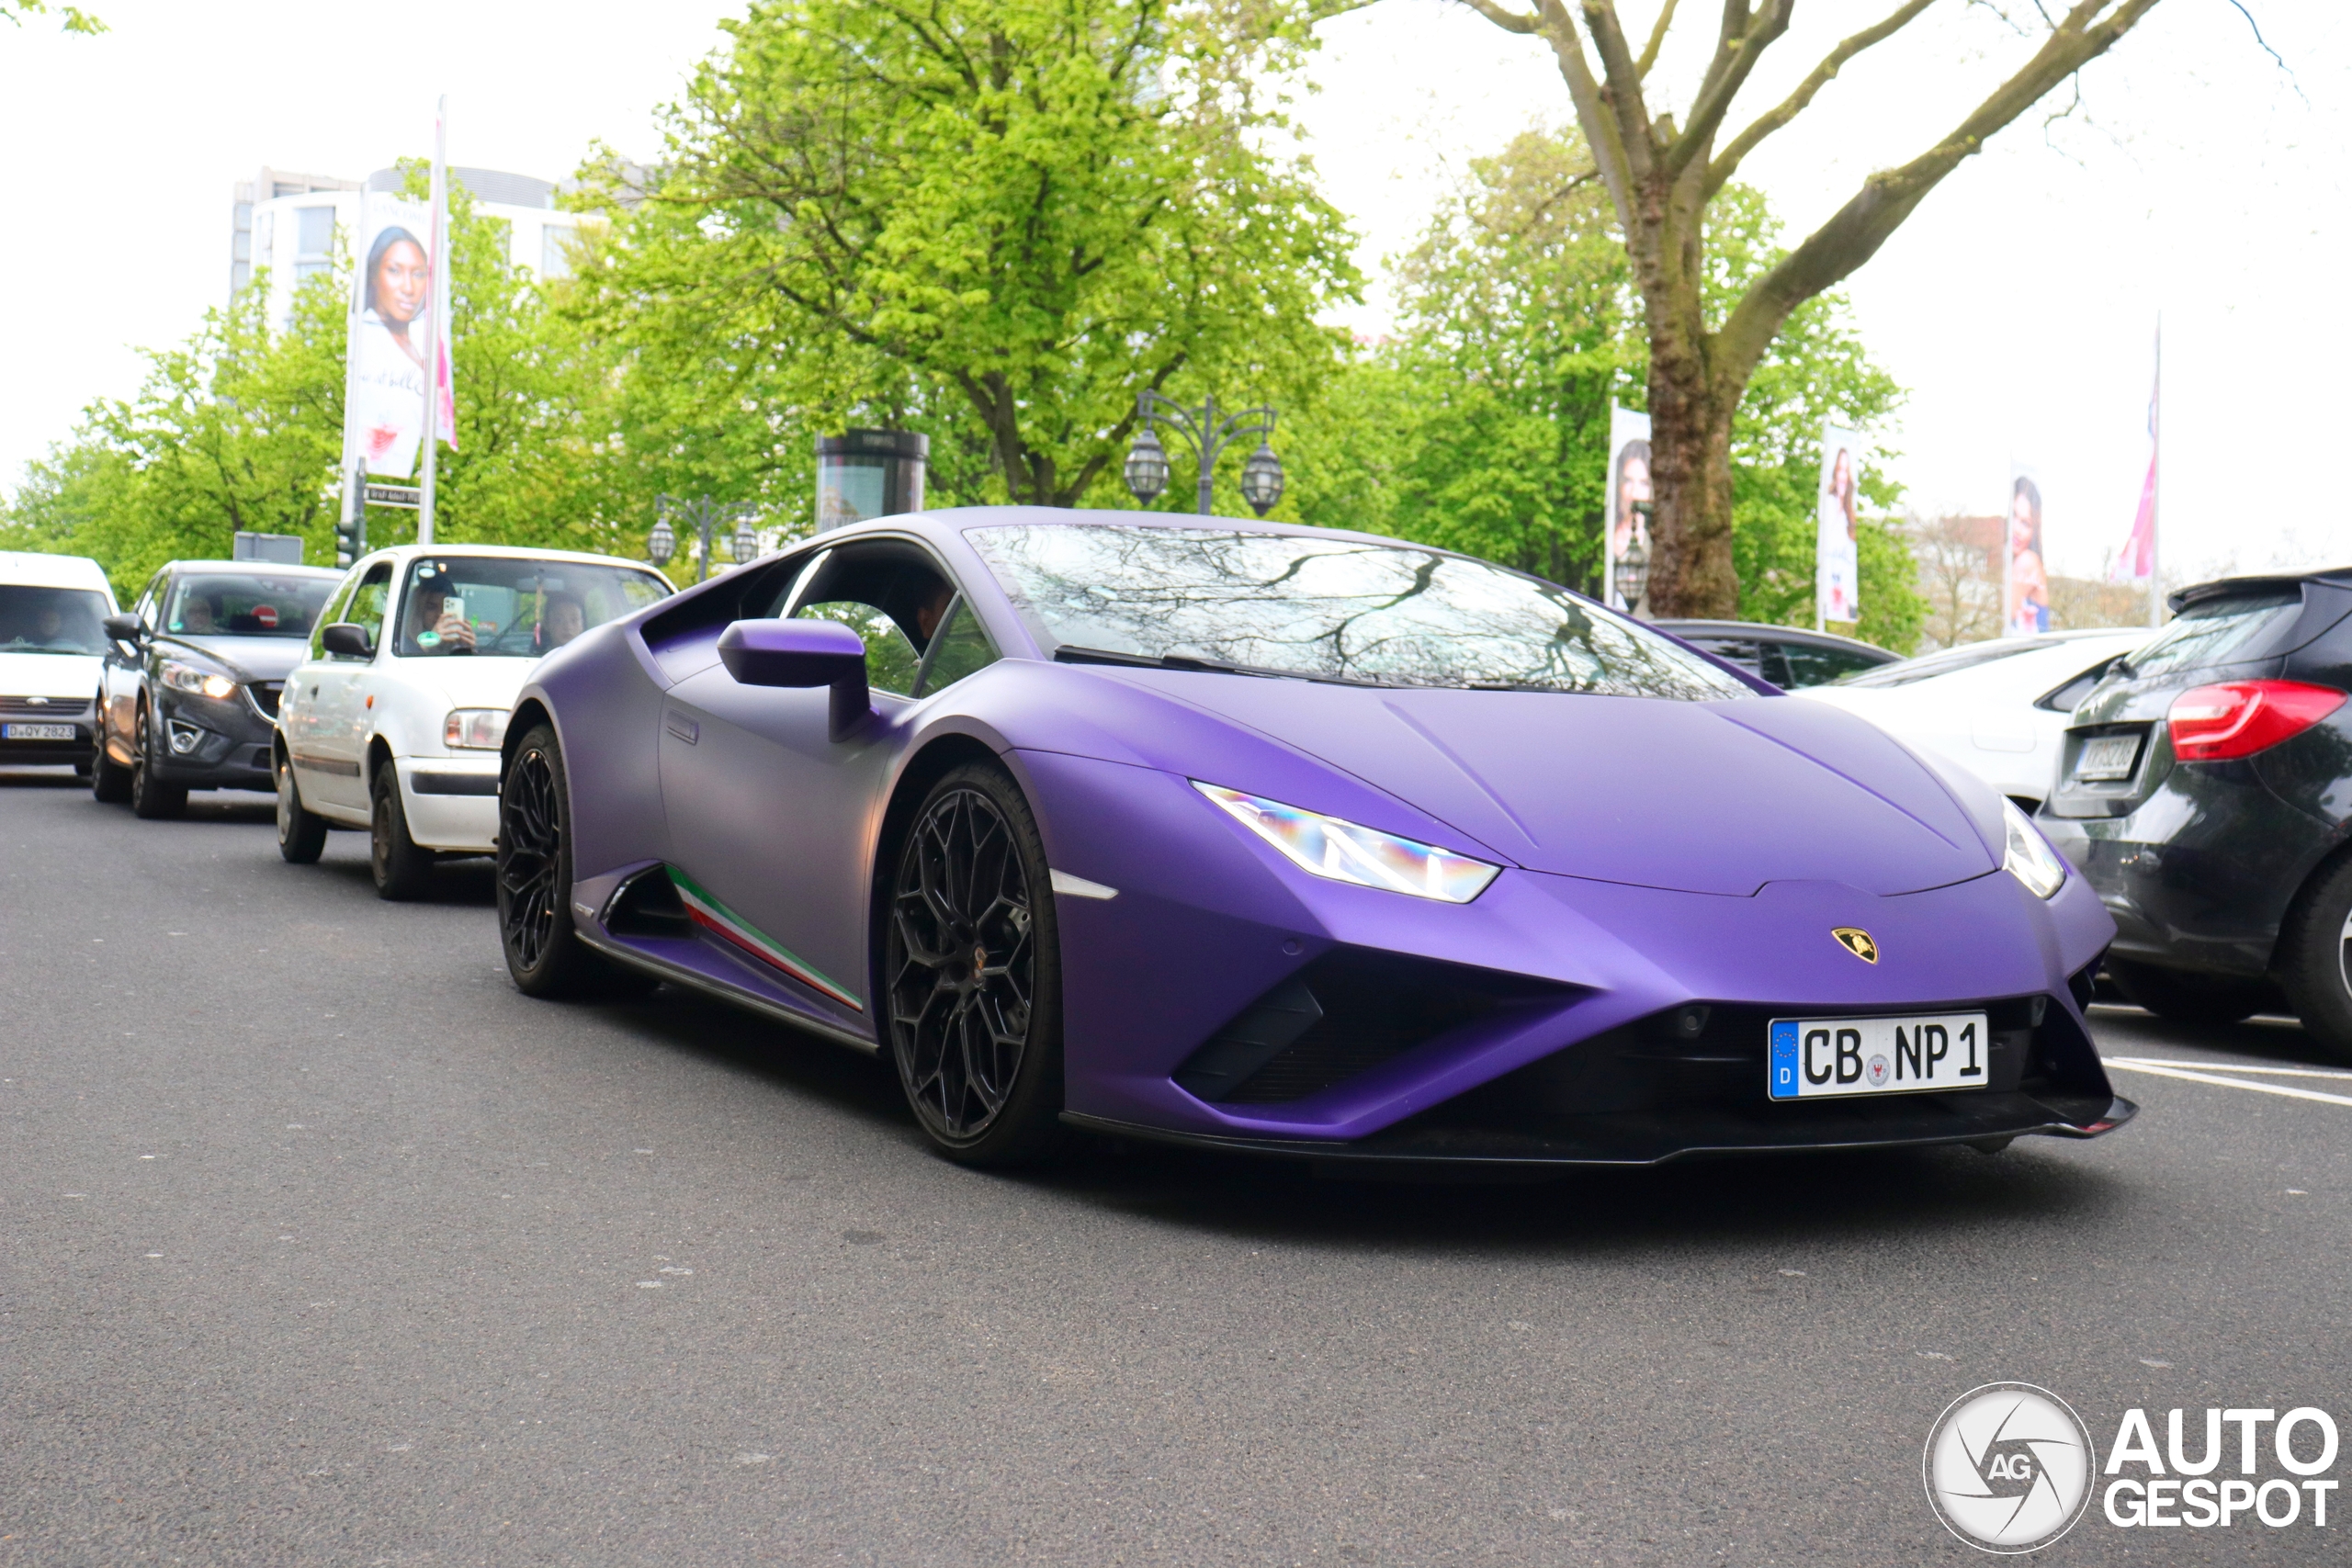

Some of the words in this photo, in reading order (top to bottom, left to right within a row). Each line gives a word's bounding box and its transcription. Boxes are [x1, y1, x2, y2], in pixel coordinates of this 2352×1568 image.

[9, 726, 17, 737] D
[25, 726, 40, 737] QY
[43, 726, 74, 737] 2823
[1804, 1028, 1863, 1085] CB
[1895, 1024, 1949, 1080] NP
[1959, 1022, 1982, 1077] 1
[1780, 1067, 1792, 1084] D
